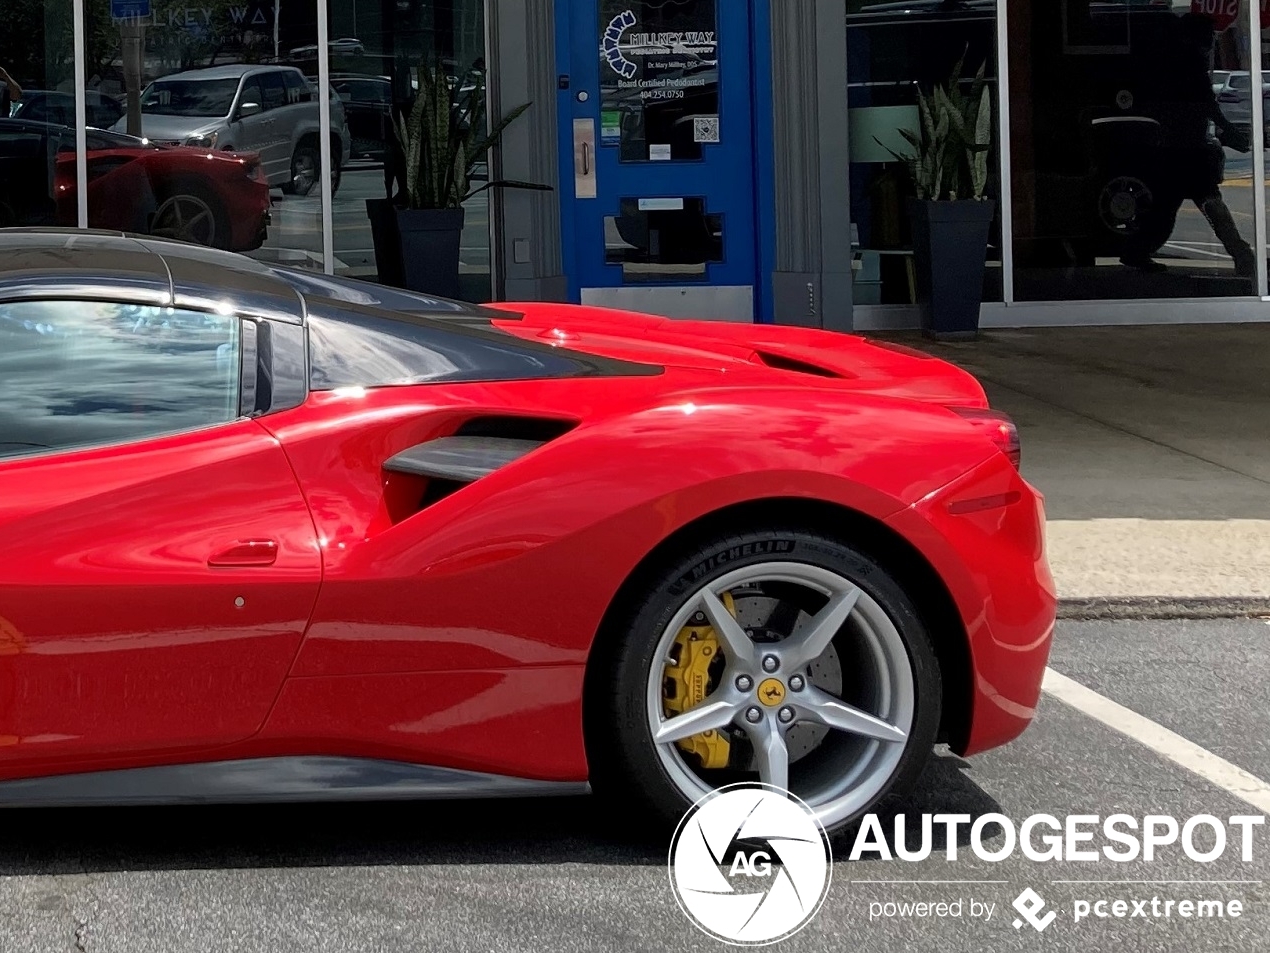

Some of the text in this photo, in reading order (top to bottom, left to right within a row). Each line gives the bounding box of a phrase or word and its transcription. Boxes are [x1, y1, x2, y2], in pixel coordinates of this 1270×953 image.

[629, 31, 715, 46] MILLKEY WAY
[617, 79, 638, 88] Board
[638, 78, 666, 88] Certified
[691, 539, 790, 579] MICHELIN
